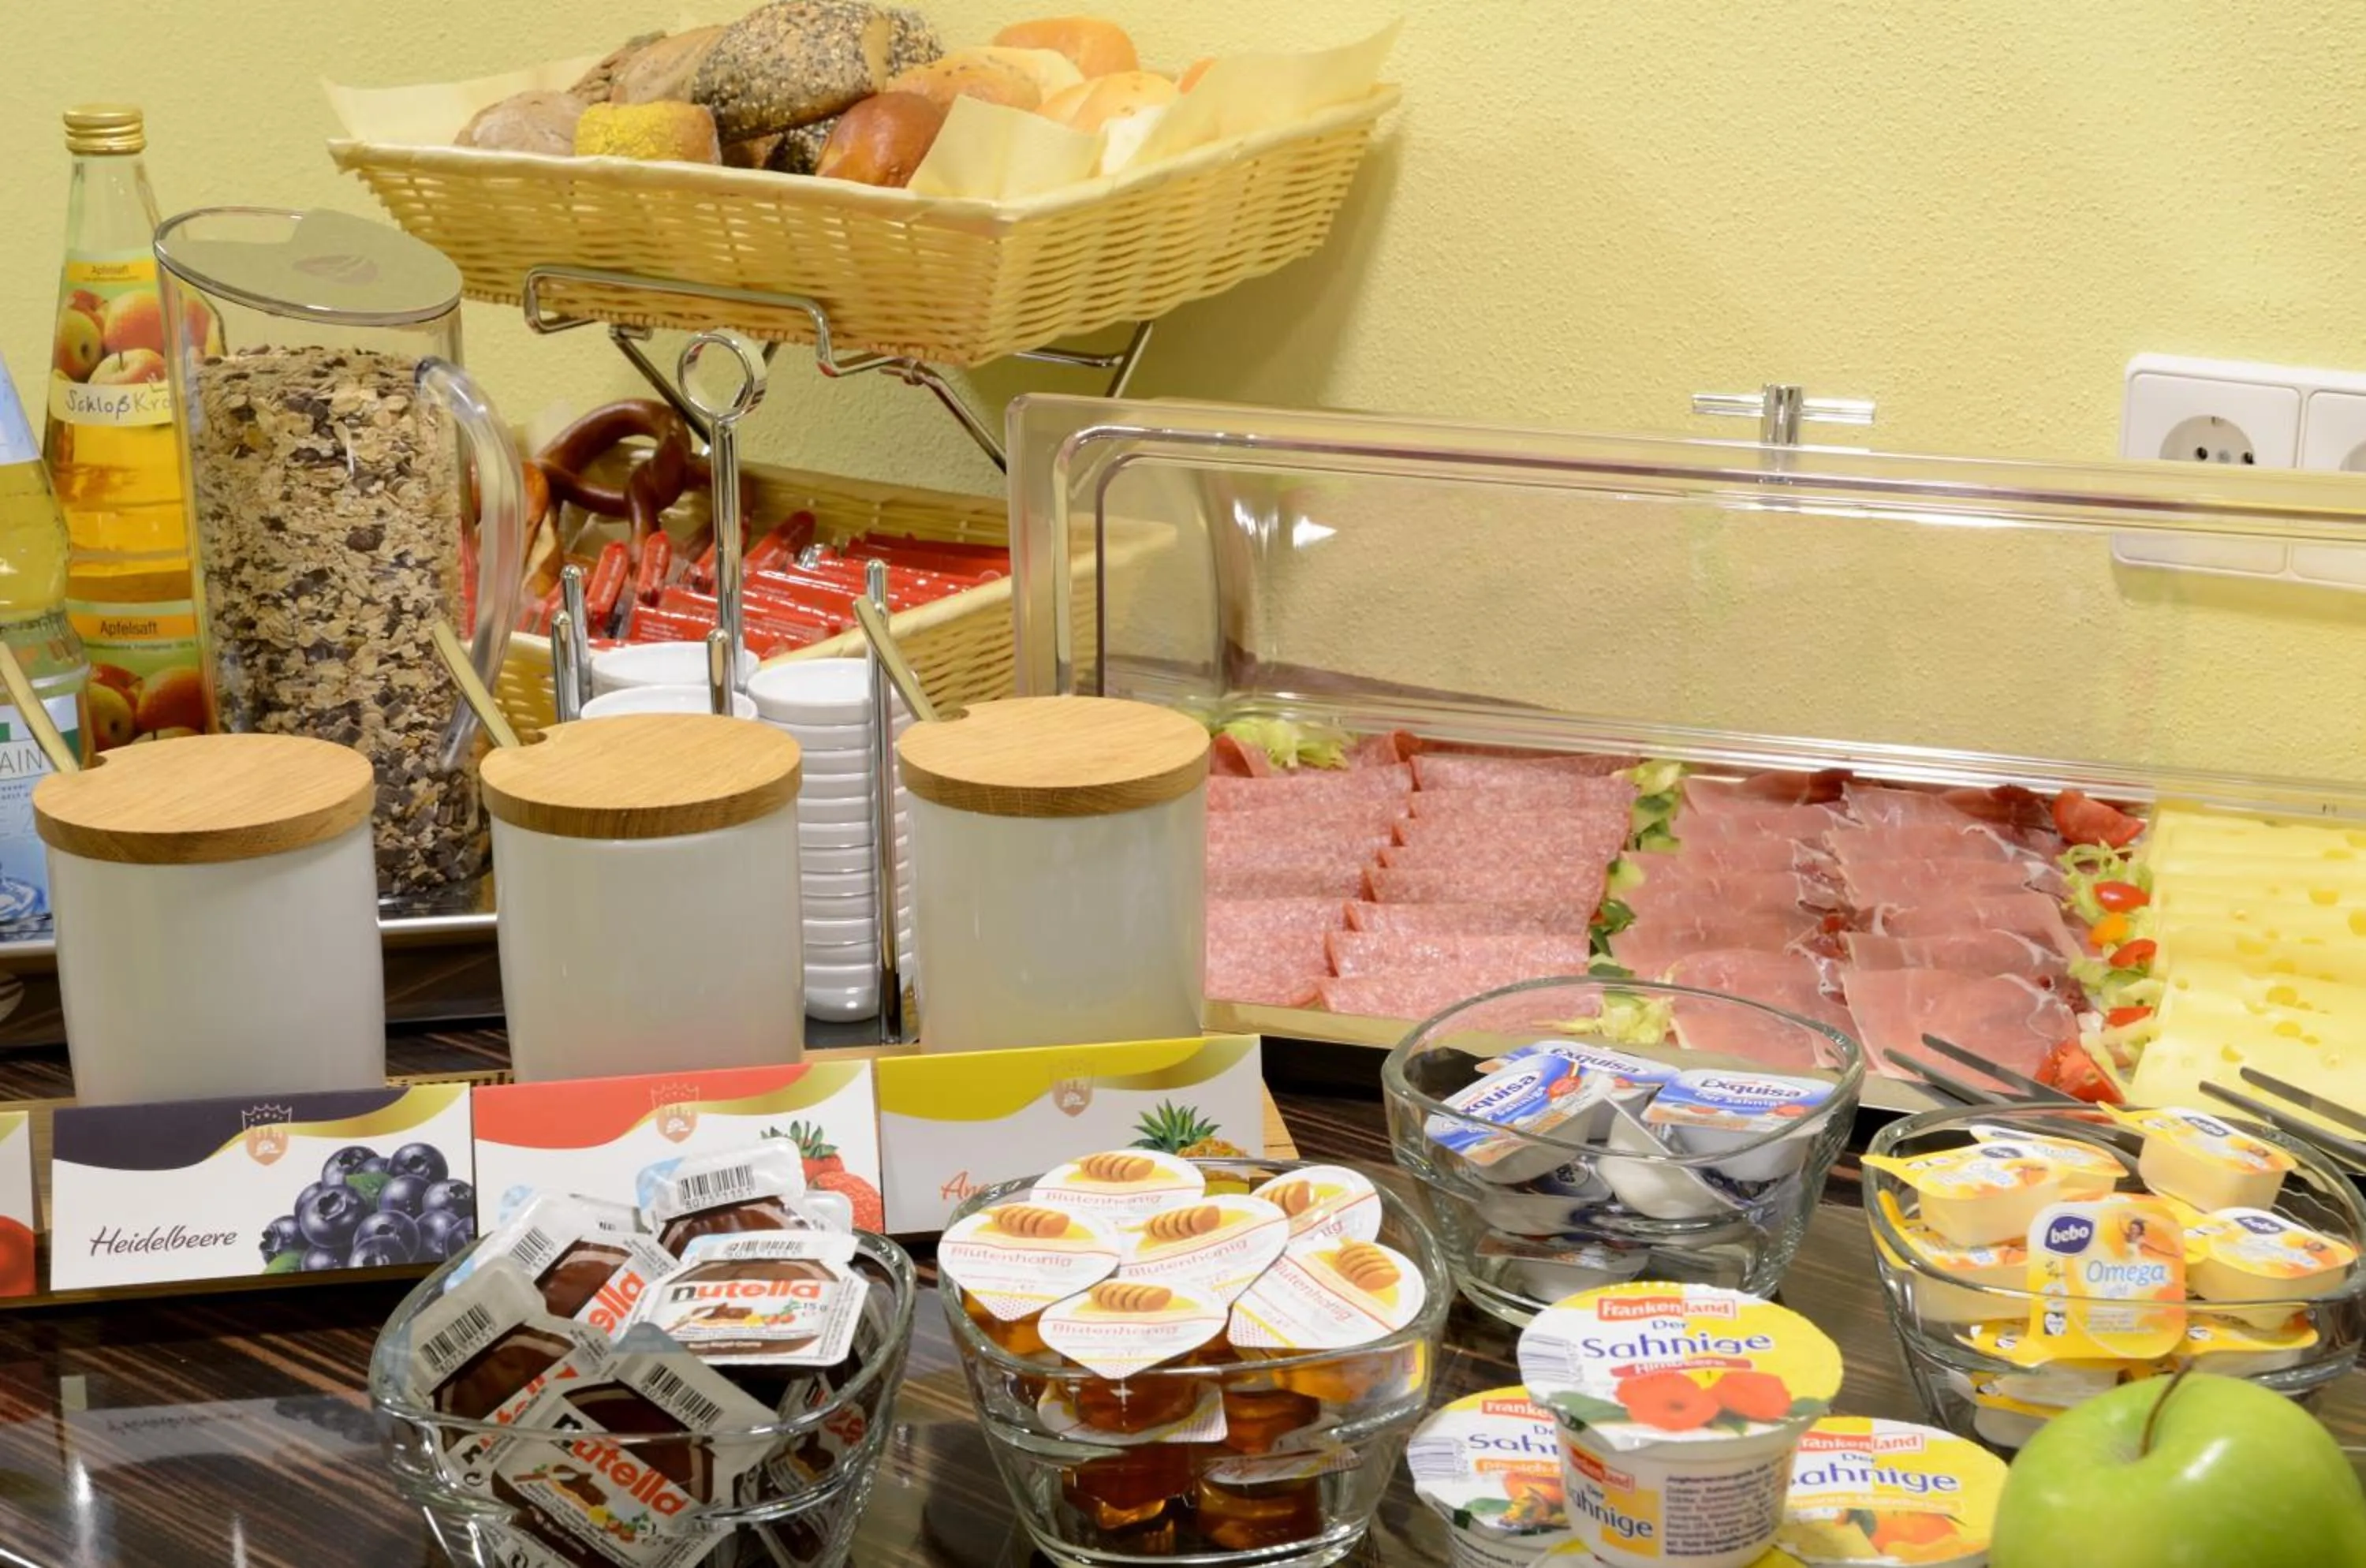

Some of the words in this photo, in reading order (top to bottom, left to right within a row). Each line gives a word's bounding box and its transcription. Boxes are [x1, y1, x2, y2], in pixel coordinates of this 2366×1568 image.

[100, 620, 158, 637] Apfelsaft
[1550, 1047, 1641, 1074] Exquisa
[1461, 1073, 1537, 1115] xquisa
[1700, 1077, 1801, 1098] Exquisa
[90, 1225, 237, 1256] Heidelbeere
[2051, 1223, 2090, 1244] bebo
[2086, 1260, 2167, 1286] Omega
[671, 1279, 821, 1301] nutella
[1603, 1301, 1730, 1316] Frankenland
[1651, 1320, 1689, 1330] Der
[1581, 1332, 1772, 1358] Sahnige
[1801, 1435, 1919, 1450] rankenland
[1790, 1462, 1957, 1493] ahnige
[1569, 1489, 1654, 1539] ahnige
